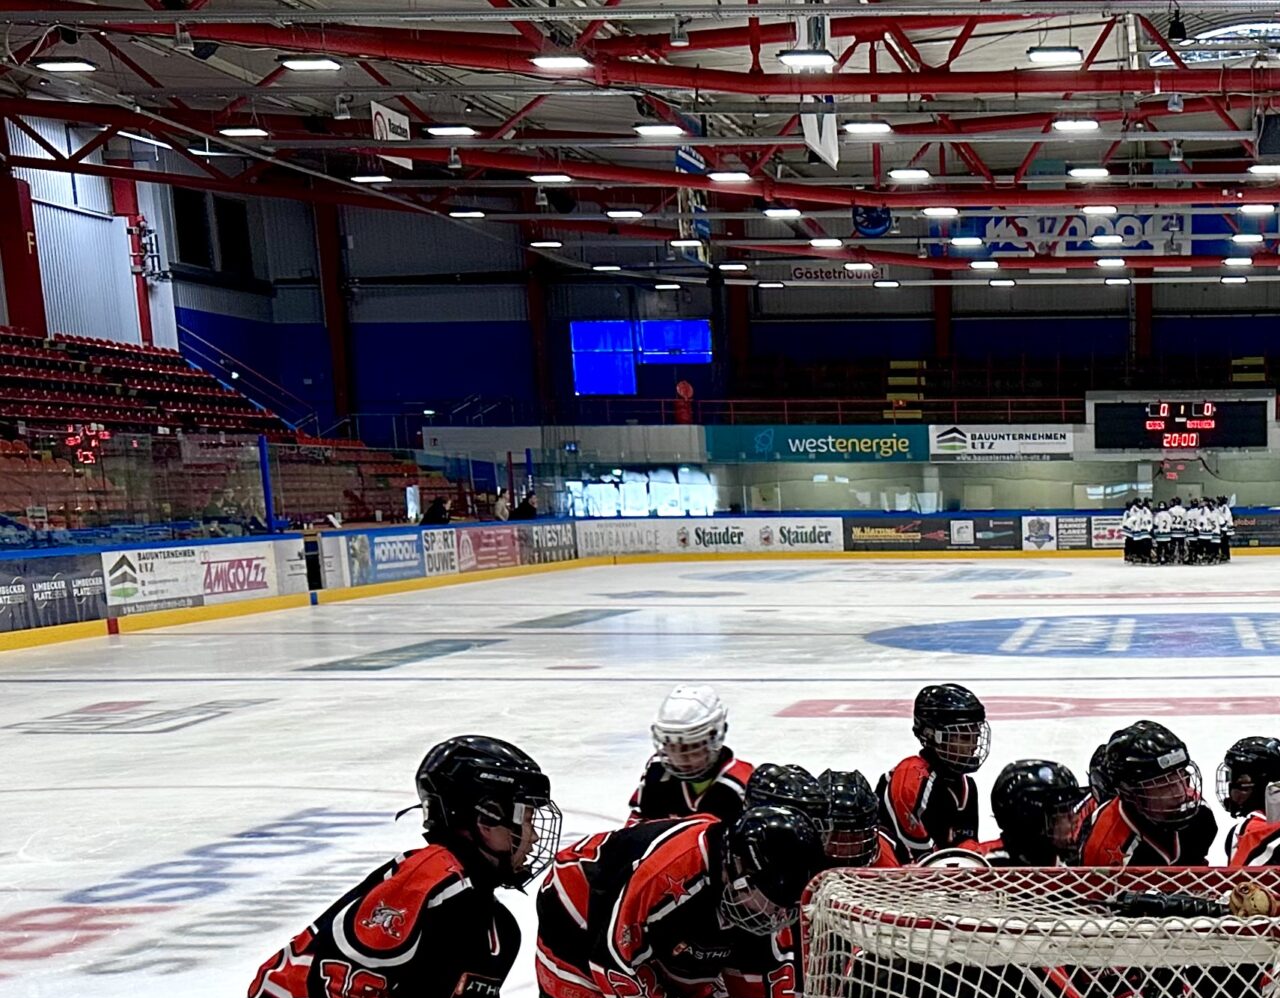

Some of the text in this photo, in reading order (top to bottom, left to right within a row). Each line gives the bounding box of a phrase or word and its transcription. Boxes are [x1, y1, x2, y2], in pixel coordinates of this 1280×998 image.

[1159, 403, 1169, 417] 0
[1203, 402, 1213, 416] 0
[970, 432, 1067, 442] BAUUNTERNEHMEN
[1163, 433, 1197, 448] 20:00
[788, 433, 910, 457] westenergie
[970, 442, 995, 450] UTZ
[532, 524, 573, 548] FIVESTAR
[695, 525, 744, 547] Stauder
[779, 524, 832, 547] Stauder
[137, 549, 196, 562] BAUUNTERNEHMEN
[427, 551, 456, 573] DUWE
[32, 580, 66, 591] LIMBECKER
[72, 577, 103, 588] LIMBECKER
